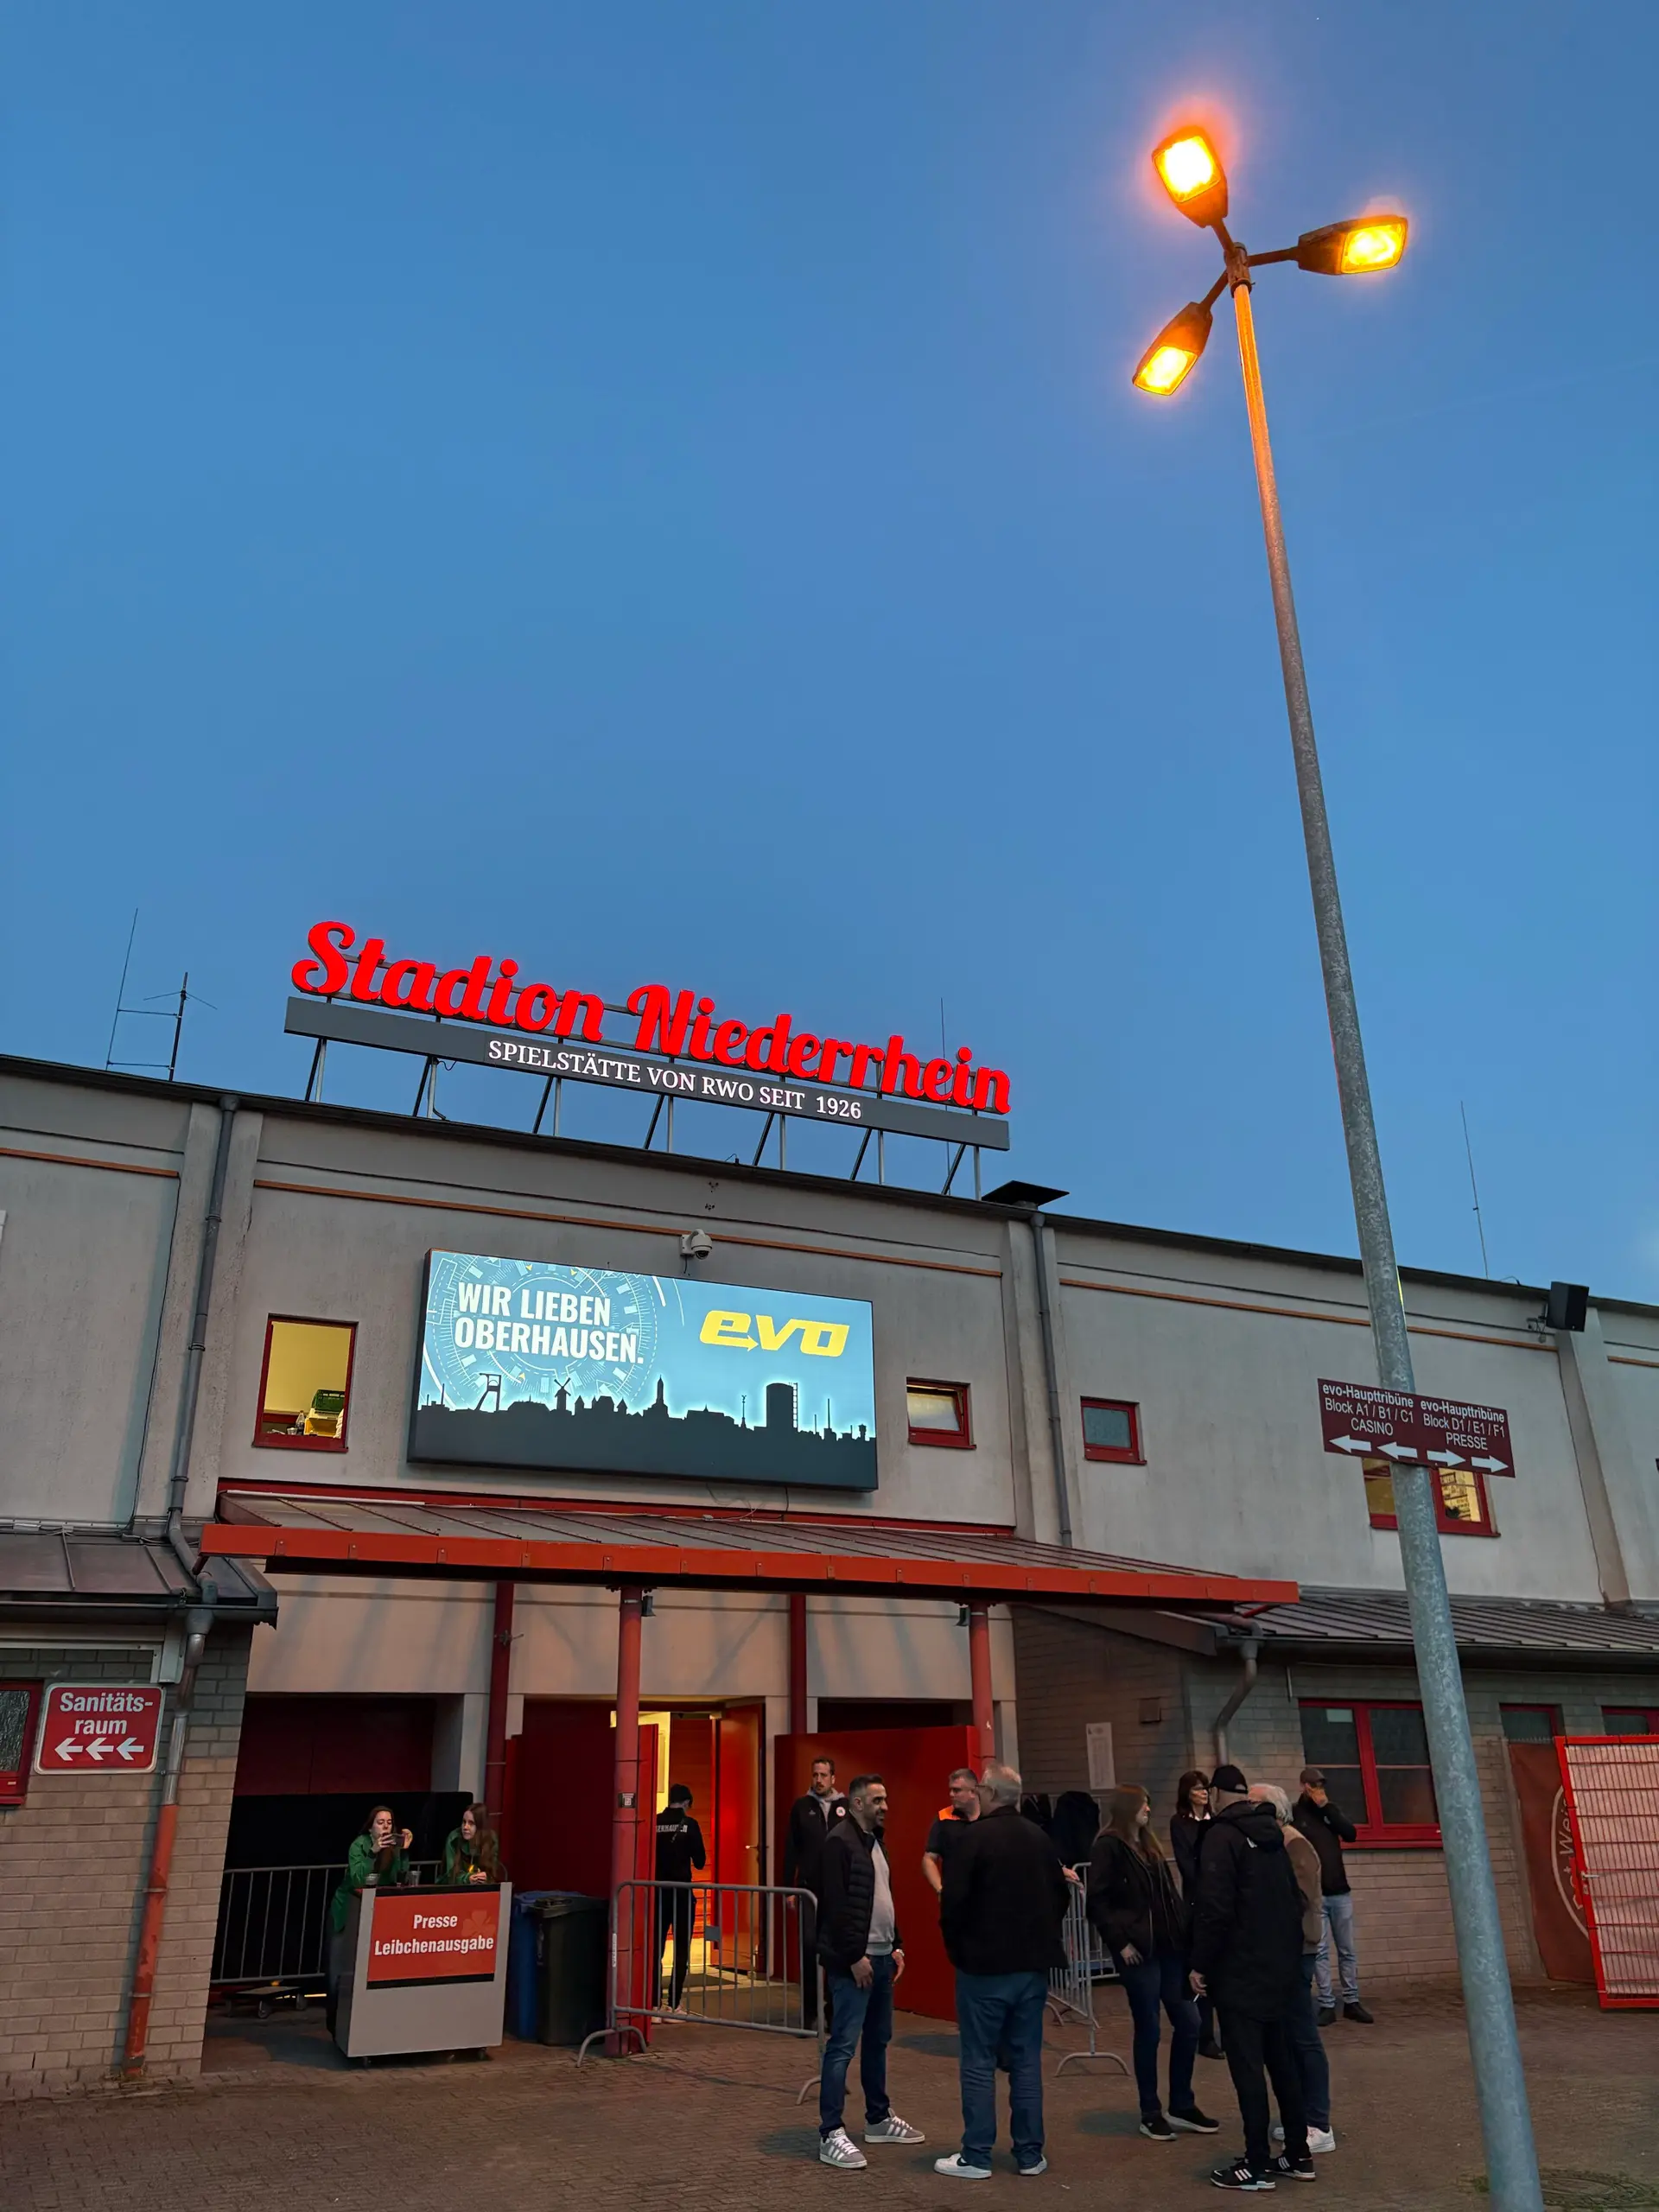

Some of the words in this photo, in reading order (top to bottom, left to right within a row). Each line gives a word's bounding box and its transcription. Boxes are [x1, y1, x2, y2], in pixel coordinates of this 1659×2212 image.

[291, 920, 605, 1042] Stadion
[627, 983, 1012, 1115] Niederrhein
[488, 1039, 641, 1084] SPIELSTÄTTE
[646, 1066, 696, 1092] VON
[701, 1076, 754, 1102] RWO
[759, 1085, 805, 1110] SEIT
[816, 1095, 862, 1121] 1926
[458, 1281, 512, 1317] WIR
[520, 1288, 611, 1327] LIEBEN
[454, 1316, 645, 1364] OBERHAUSEN.
[699, 1309, 850, 1357] evo
[1322, 1383, 1414, 1408] evo-Haupttribüne
[1325, 1397, 1354, 1415] Block
[1356, 1402, 1370, 1417] A1
[1378, 1406, 1392, 1421] B1
[1400, 1409, 1414, 1424] C1
[1420, 1400, 1505, 1423] evo-Haupttribüne
[1351, 1417, 1394, 1436] CASINO
[1423, 1413, 1450, 1429] Block
[1452, 1417, 1465, 1432] D1
[1473, 1421, 1485, 1435] E1
[1493, 1424, 1505, 1439] F1
[1446, 1432, 1488, 1451] PRESSE
[60, 1692, 154, 1713] Sanitäts-
[74, 1719, 128, 1735] raum
[413, 1913, 458, 1929] Presse
[374, 1934, 494, 1956] Leibchenausgabe
